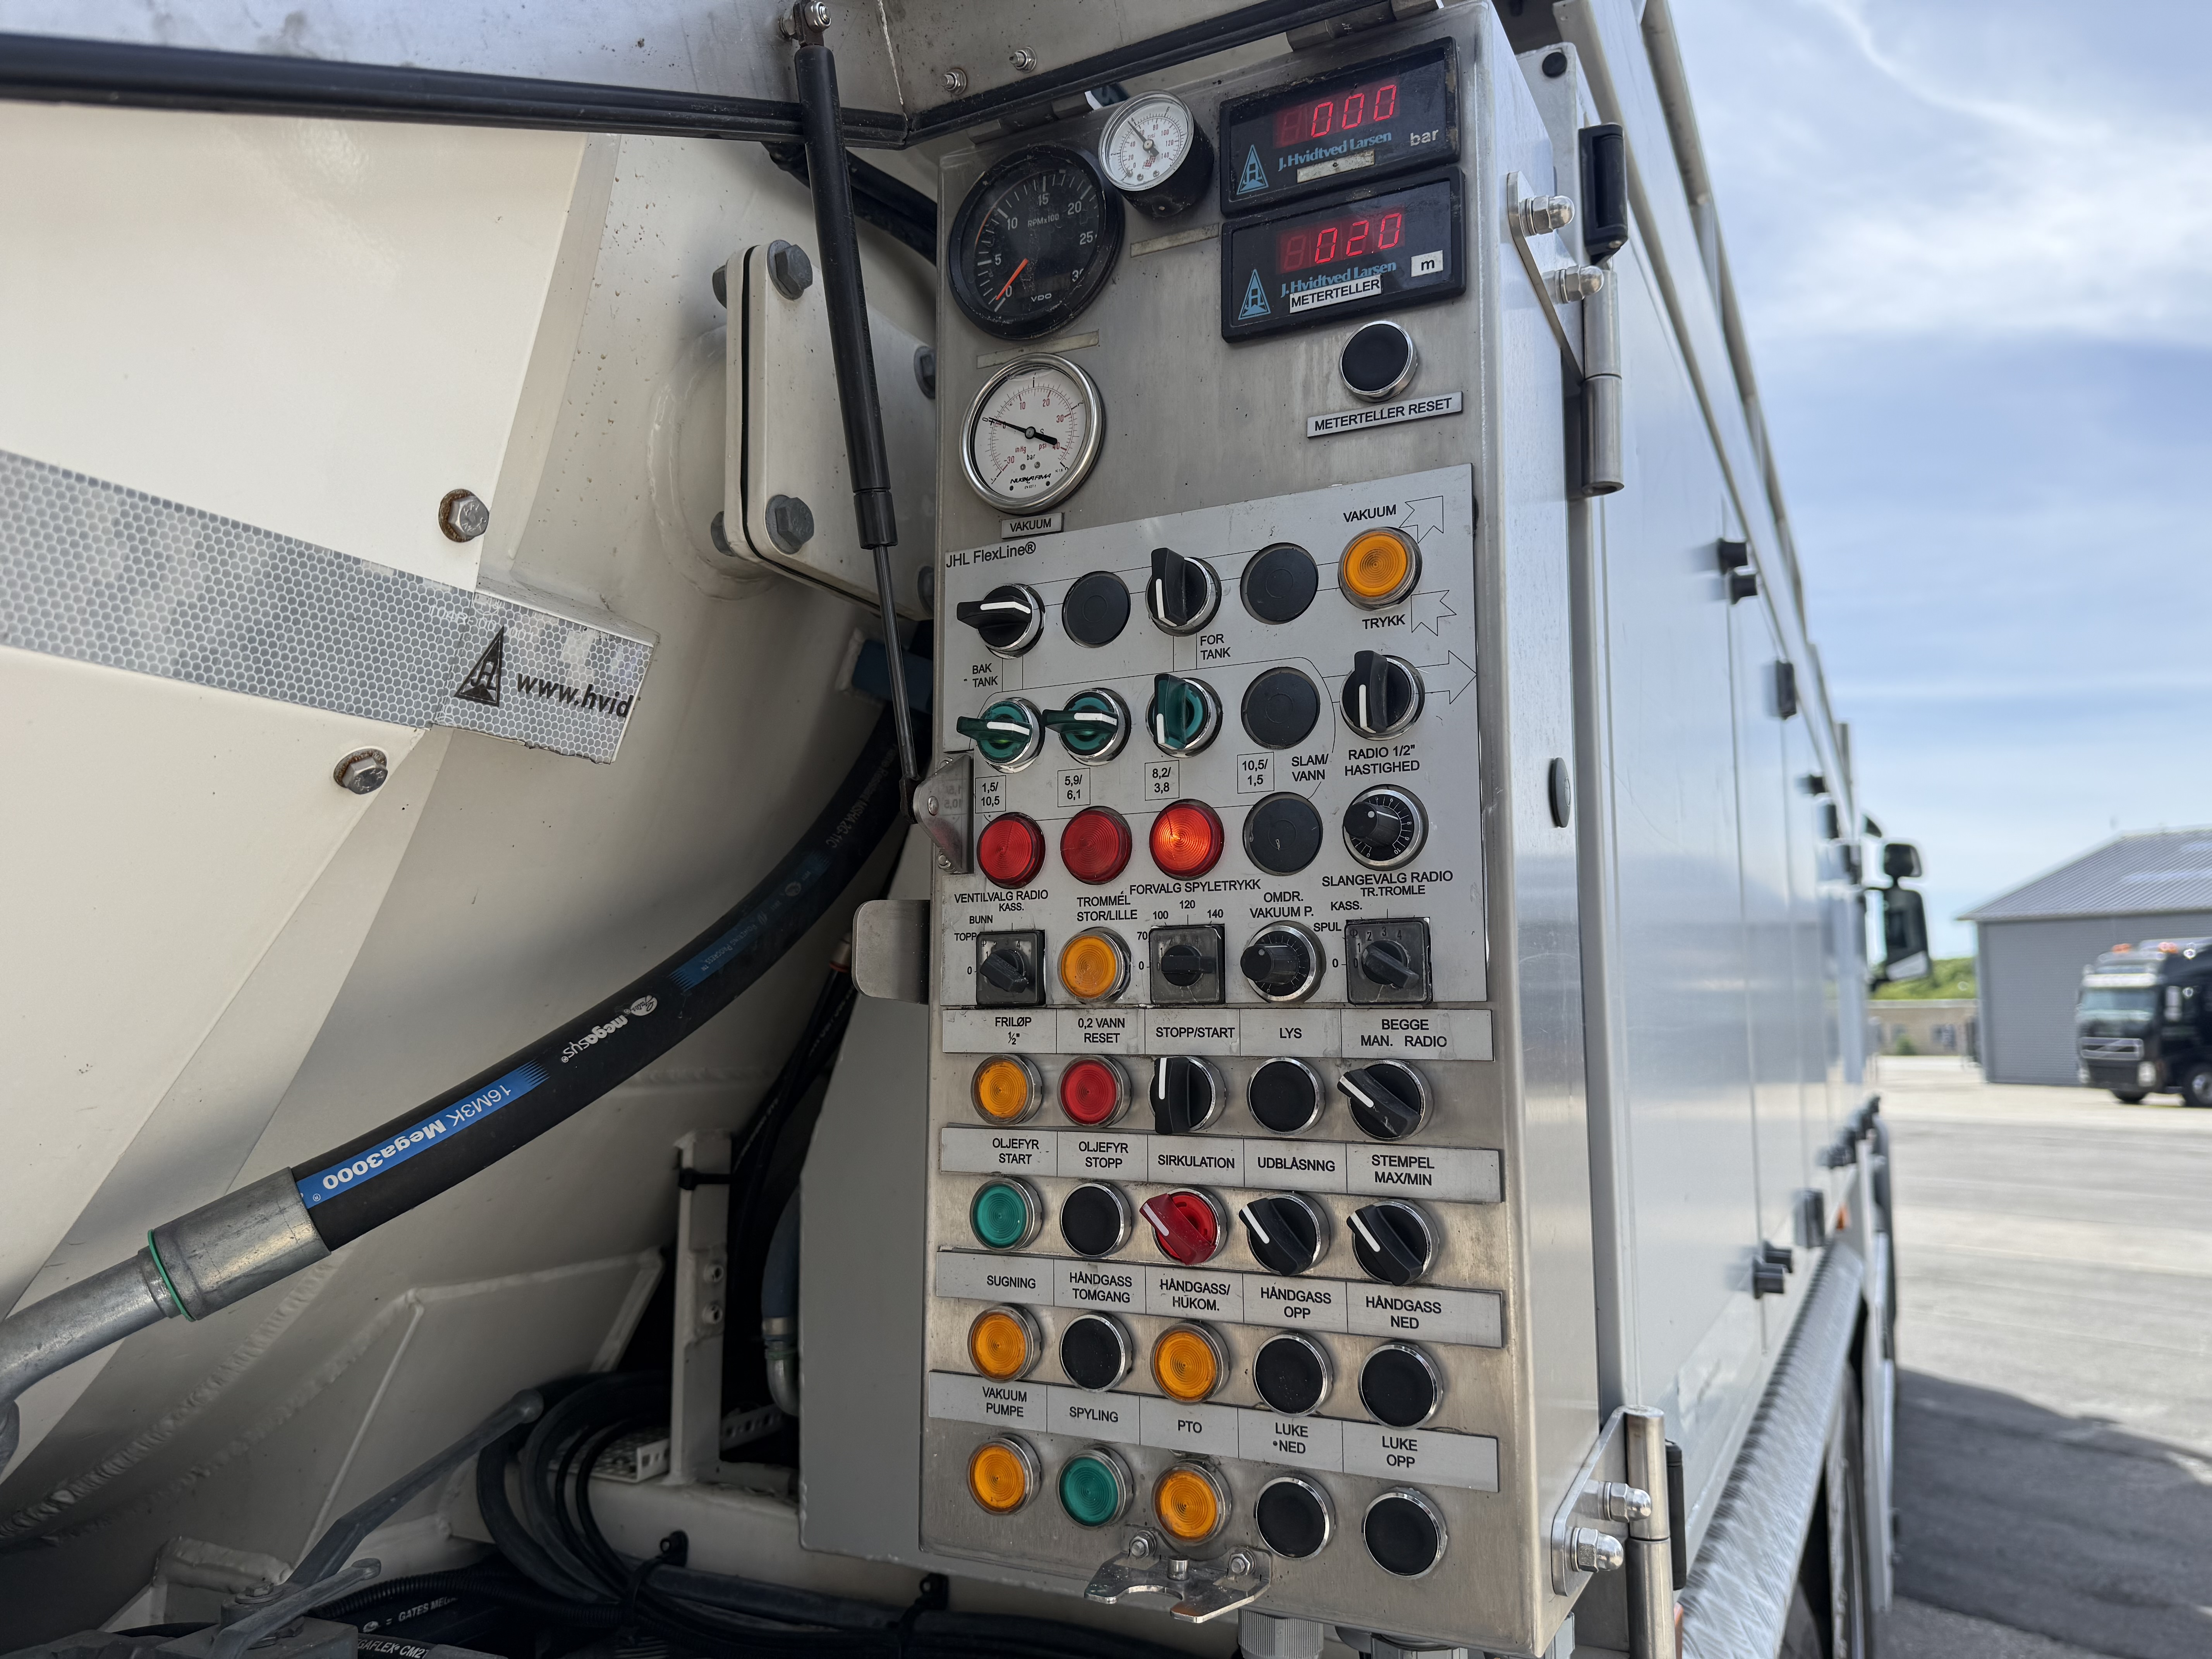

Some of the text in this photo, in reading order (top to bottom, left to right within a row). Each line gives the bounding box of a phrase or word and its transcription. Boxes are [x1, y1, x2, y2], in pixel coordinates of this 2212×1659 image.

[1310, 84, 1396, 138] 000
[1350, 131, 1392, 150] Larsen
[1410, 129, 1439, 147] bar
[1038, 194, 1049, 206] 15
[1068, 201, 1082, 215] 20
[1007, 218, 1018, 230] 10
[1028, 213, 1060, 227] RPMx100
[1080, 231, 1094, 245] 25
[1315, 213, 1401, 264] 020
[995, 254, 1001, 265] 5
[1421, 259, 1435, 271] m
[1354, 262, 1396, 278] Larsen
[1006, 285, 1012, 297] 0
[1031, 293, 1052, 302] VDO
[1291, 279, 1380, 307] METERTELLER
[1020, 402, 1025, 410] 10
[1042, 398, 1050, 407] 20
[1056, 415, 1064, 423] 30
[1315, 398, 1452, 431] METERTELLER RESET
[1343, 504, 1396, 522] VAKUUM
[1010, 519, 1051, 532] VAKUUM
[946, 553, 969, 568] JHL
[1362, 614, 1405, 630] TRYKK
[1200, 634, 1224, 646] FOR
[1200, 647, 1231, 660] TANK
[972, 663, 992, 675] BAK
[972, 676, 998, 687] TANK
[517, 673, 634, 718] www.hvid
[1291, 753, 1329, 767] SLAM/
[1348, 747, 1389, 760] RADIO
[1242, 758, 1268, 771] 10,5/
[1345, 760, 1420, 776] HASTIGHED
[1152, 767, 1171, 779] 8,2/
[1292, 769, 1325, 782] VANN
[1065, 775, 1082, 787] 5,9/
[1248, 774, 1264, 786] 1,5
[982, 781, 999, 794] 1,5/
[1154, 782, 1170, 793] 3,8
[981, 796, 1000, 807] 10,5
[1067, 789, 1081, 801] 6,1
[1322, 870, 1453, 887] SLANGEVALG RADIO
[1130, 879, 1261, 895] FORVALG SPYLETRYKK
[1360, 885, 1425, 896] TR.TROMLE
[954, 890, 1048, 903] VENTILVALG RADIO
[1264, 891, 1304, 903] OMDR.
[999, 902, 1024, 912] KASS.
[1179, 900, 1195, 909] 120
[1331, 901, 1362, 910] KASS.
[1077, 909, 1137, 922] STOR/LILLE
[1153, 911, 1168, 919] 100
[1207, 909, 1224, 918] 140
[1250, 906, 1314, 918] VAKUUM P.
[969, 915, 993, 924] BUNN
[1314, 922, 1341, 932] SPUL
[1382, 926, 1386, 936] 3
[954, 933, 977, 941] TOPP
[1137, 931, 1148, 940] 70
[1367, 931, 1372, 941] 2
[1397, 929, 1402, 940] 4
[1358, 943, 1360, 953] 1
[1139, 962, 1144, 970] 0
[1333, 958, 1338, 967] 0
[967, 966, 972, 975] 0
[995, 1017, 1032, 1027] FRILØP
[1078, 1018, 1125, 1029] 0,2 VANN
[1381, 1019, 1429, 1030] BEGGE
[1084, 1032, 1120, 1044] RESET
[1156, 1027, 1235, 1038] STOPP/START
[1280, 1027, 1302, 1039] LYS
[1361, 1035, 1447, 1048] MAN. RADIO
[446, 1084, 511, 1127] 16M3K
[992, 1138, 1039, 1150] OLJEFYR
[1079, 1142, 1128, 1154] OLJEFYR
[999, 1153, 1032, 1164] START
[1085, 1157, 1123, 1168] STOPP
[1158, 1155, 1235, 1168] SIRKULATION
[1257, 1157, 1335, 1172] UDBLÅSNNG
[1371, 1154, 1435, 1169] STEMPEL
[1374, 1171, 1432, 1186] MAX/MIN
[987, 1275, 1036, 1289] SUGNING
[1069, 1271, 1132, 1287] HÅNDGASS
[1160, 1278, 1230, 1295] HÅNDGASS/
[1072, 1288, 1130, 1303] TOMGANG
[1261, 1286, 1332, 1304] HÅNDGASS
[1173, 1296, 1219, 1311] HUKOM.
[1366, 1295, 1442, 1314] HÅNDGASS
[1284, 1306, 1310, 1319] OPP
[1391, 1315, 1419, 1329] NED
[982, 1386, 1027, 1402] VAKUUM
[986, 1403, 1024, 1417] PUMPE
[1069, 1407, 1118, 1422] SPYLING
[1178, 1419, 1202, 1433] PTO
[1275, 1422, 1308, 1438] LUKE
[1382, 1436, 1418, 1451] LUKE
[1386, 1454, 1415, 1468] OPP
[398, 1602, 429, 1622] GATES
